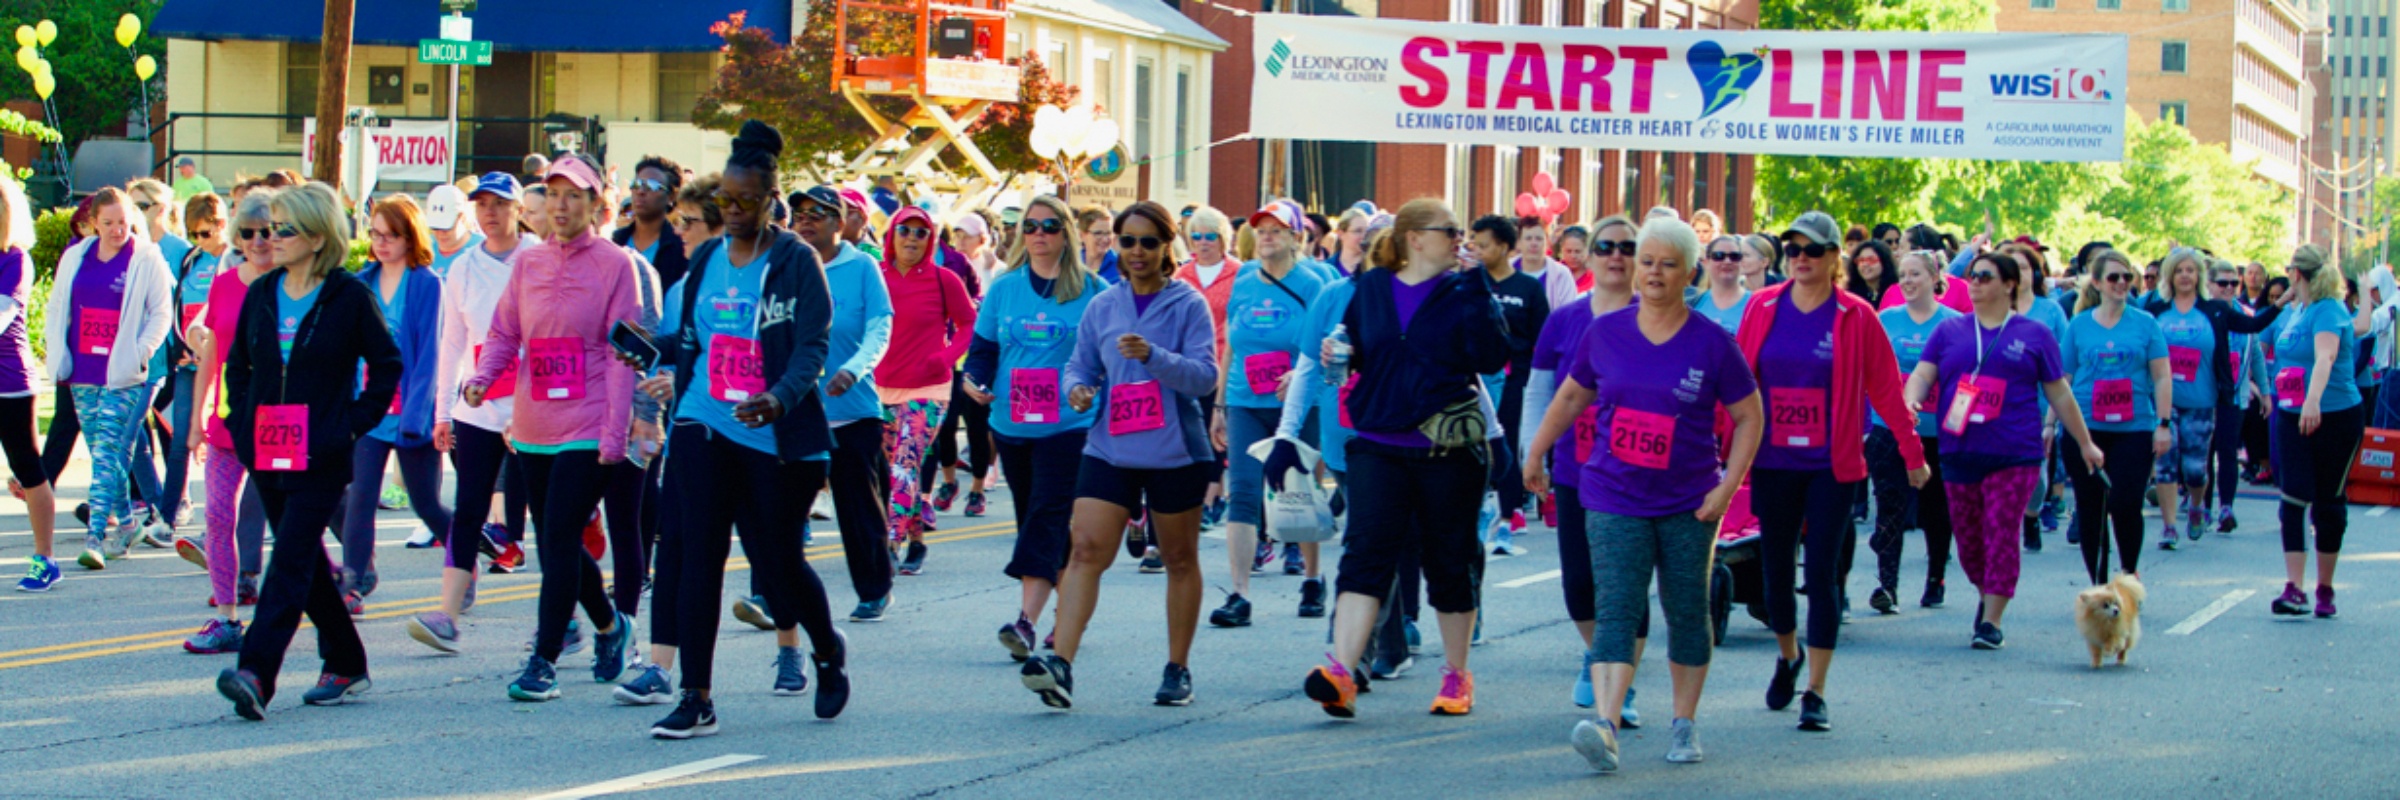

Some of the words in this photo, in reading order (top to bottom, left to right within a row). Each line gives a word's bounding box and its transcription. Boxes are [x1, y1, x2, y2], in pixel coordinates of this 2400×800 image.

[423, 44, 467, 61] LINCOLN
[1292, 55, 1388, 71] LEXINGTON
[1291, 71, 1339, 80] MEDICAL
[1344, 72, 1387, 82] CENTER
[1398, 36, 1669, 114] START
[1768, 48, 1966, 122] LINE
[1395, 113, 1487, 131] LEXINGTON
[1493, 115, 1563, 134] MEDICAL
[1570, 117, 1633, 136] CENTER
[1639, 119, 1693, 137] HEART
[1725, 121, 1768, 139] SOLE
[1776, 123, 1858, 142] WOMEN'S
[1865, 125, 1904, 143] FIVE
[1910, 126, 1965, 145] MILER
[1985, 122, 1993, 132] A
[1995, 122, 2050, 133] CAROLINA
[2052, 123, 2112, 135] MARATHON
[1993, 136, 2065, 147] ASSOCIATION
[2067, 137, 2103, 148] EVENT
[533, 355, 576, 377] 2061
[713, 354, 764, 379] 2198
[1012, 384, 1055, 403] 2196
[1111, 396, 1159, 422] 2372
[1775, 405, 1818, 424] 2291
[259, 424, 303, 446] 2279
[1615, 427, 1667, 456] 2156
